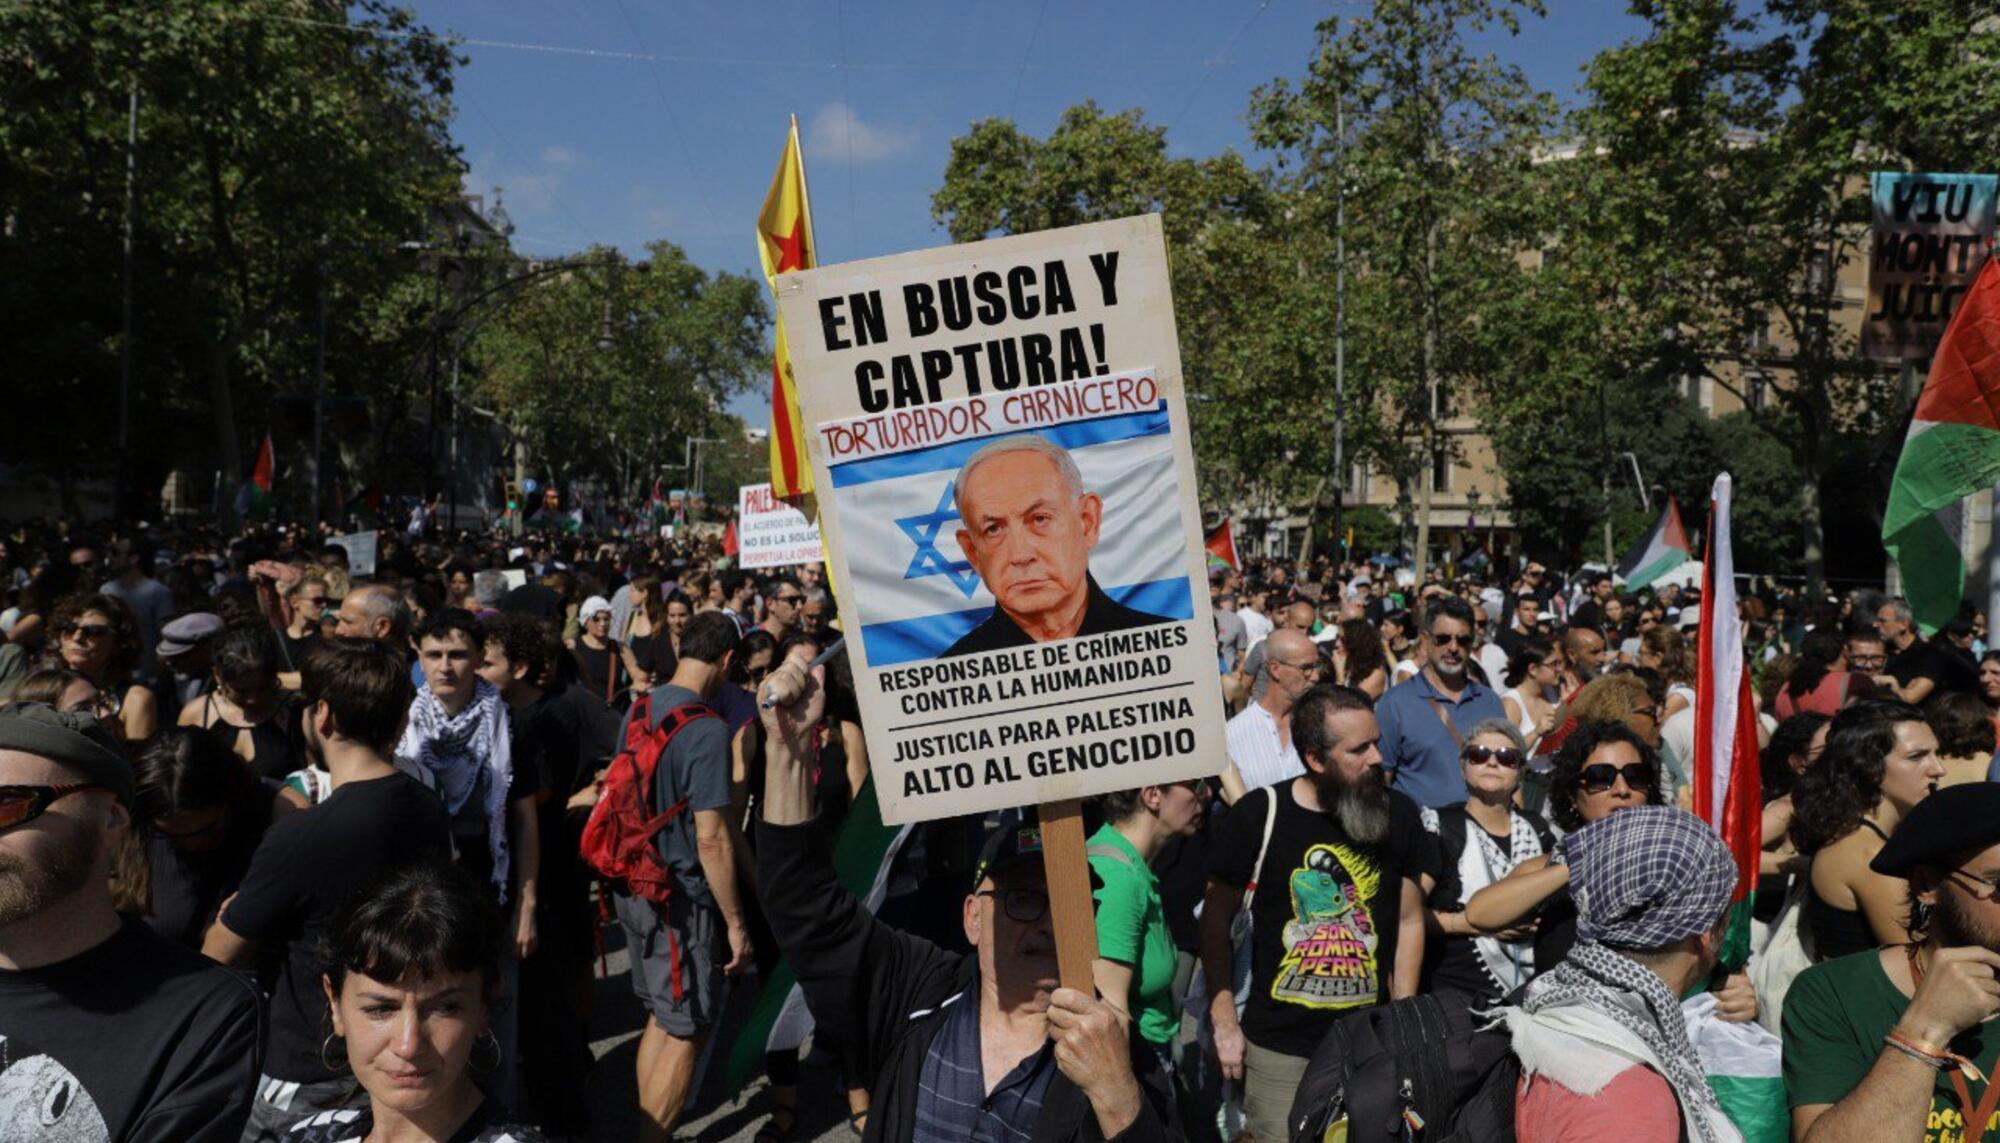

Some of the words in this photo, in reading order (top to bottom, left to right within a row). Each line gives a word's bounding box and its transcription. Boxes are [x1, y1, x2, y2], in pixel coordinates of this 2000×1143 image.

[1893, 183, 1974, 223] VIU
[1874, 232, 1981, 274] MONT
[817, 289, 889, 352] EN
[902, 259, 1077, 339] BUSCA
[1089, 250, 1120, 307] Y
[854, 322, 1110, 415] CAPTURA!
[821, 398, 991, 458] TORTURADOR
[744, 536, 757, 547] NO
[760, 535, 771, 546] ES
[774, 534, 786, 544] LA
[744, 551, 783, 563] PERPETUA
[785, 549, 796, 560] LA
[878, 649, 1038, 693] RESPONSABLE
[1042, 644, 1071, 668] DE
[1074, 625, 1189, 662] CRÍMENES
[900, 682, 993, 715] CONTRA
[996, 677, 1027, 700] LA
[1030, 654, 1173, 696] HUMANIDAD
[893, 728, 995, 763] JUSTICIA
[998, 718, 1062, 748] PARA
[1065, 696, 1195, 737] PALESTINA
[903, 762, 976, 798] ALTO
[983, 756, 1022, 786] AL
[1027, 727, 1197, 779] GENOCIDIO
[1290, 940, 1371, 960] ROMPE
[1311, 924, 1354, 940] SON
[1297, 957, 1369, 978] PERA
